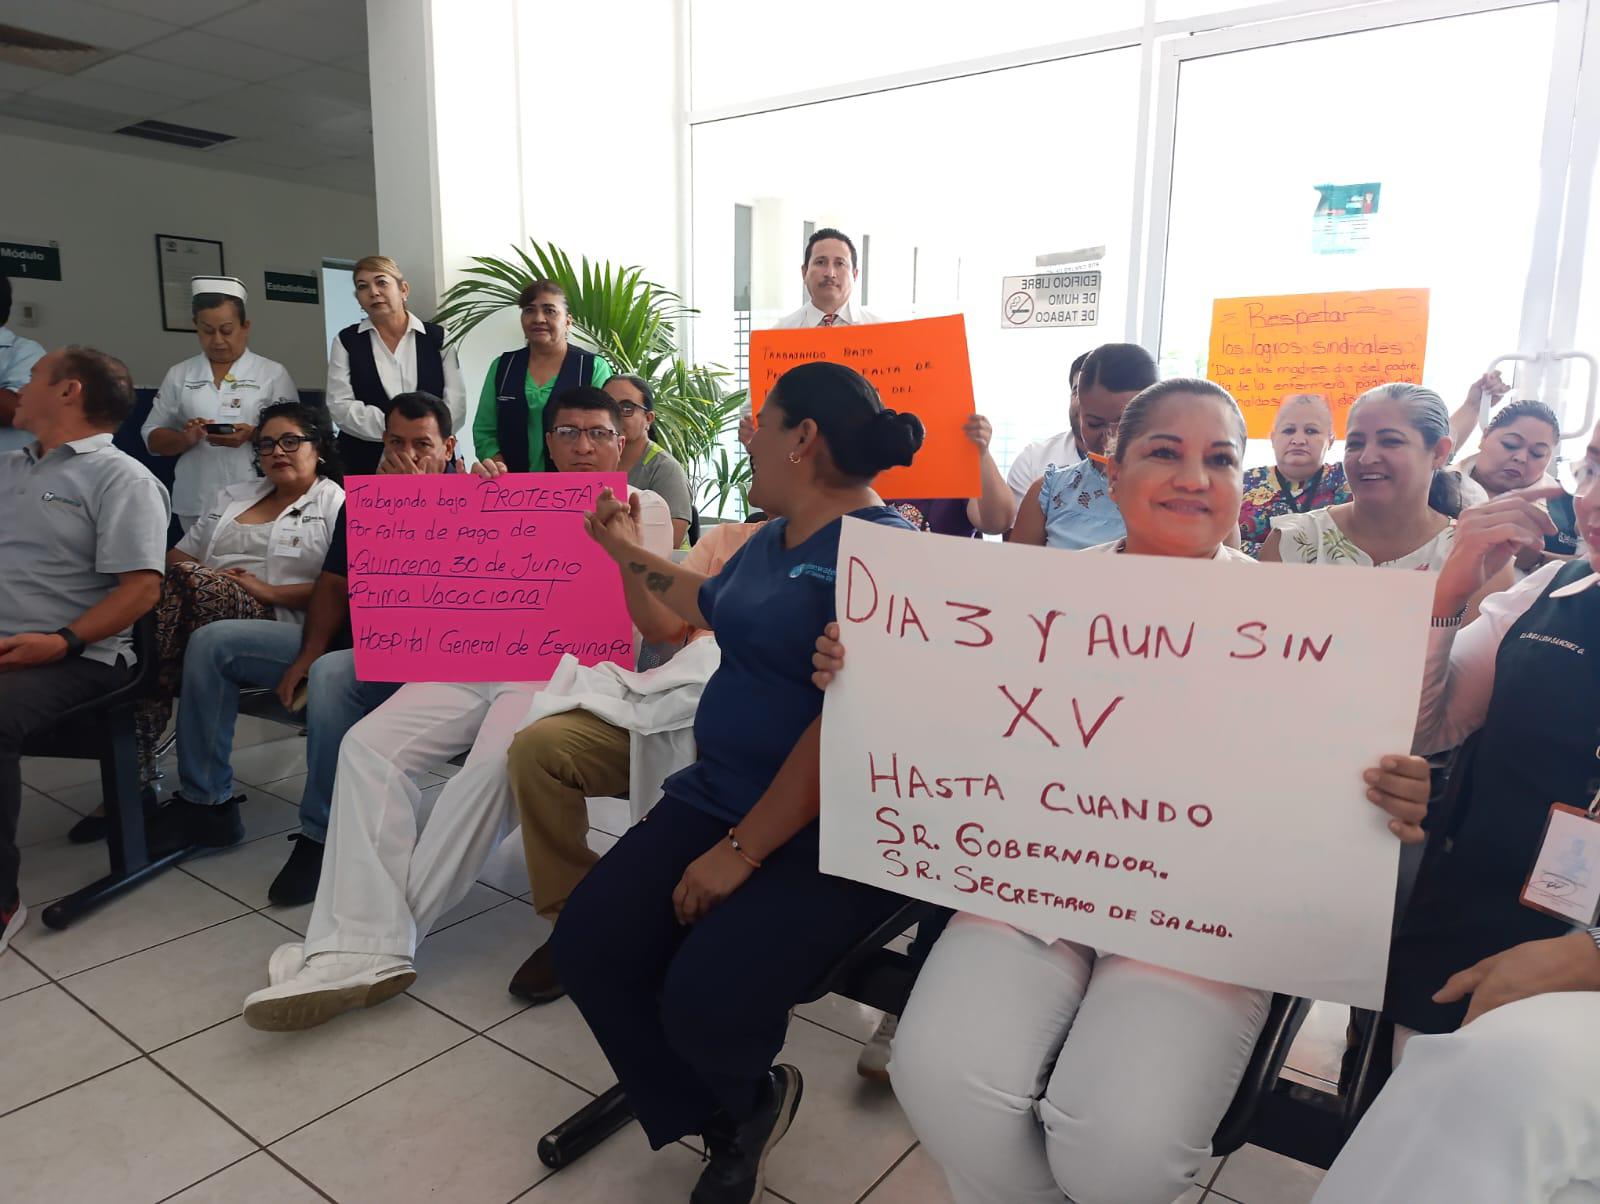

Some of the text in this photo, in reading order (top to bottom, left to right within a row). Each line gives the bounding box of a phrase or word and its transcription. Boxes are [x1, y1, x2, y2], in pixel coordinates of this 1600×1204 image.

[1, 247, 45, 260] Módulo
[20, 263, 27, 273] 1
[1244, 299, 1354, 335] Respetar
[843, 347, 874, 358] BAJO
[1251, 333, 1304, 363] logros
[1313, 334, 1402, 356] sindicales
[914, 360, 934, 371] DE
[349, 484, 427, 515] Trabajando
[437, 487, 468, 515] bajo
[348, 519, 372, 537] Por
[425, 517, 448, 541] de
[510, 517, 537, 537] de
[353, 548, 441, 574] Quincena
[449, 556, 479, 574] 30
[484, 550, 506, 572] de
[351, 580, 410, 606] Prima
[359, 624, 432, 653] Hospital
[439, 629, 502, 655] General
[506, 628, 529, 656] de
[945, 600, 994, 647] 3
[1028, 610, 1067, 663] Y
[1087, 613, 1195, 659] AUN
[1229, 621, 1333, 663] SIN
[868, 751, 1213, 827] HASTA CUANDO
[953, 865, 1095, 914] SECRETARIO
[1108, 905, 1138, 922] DE
